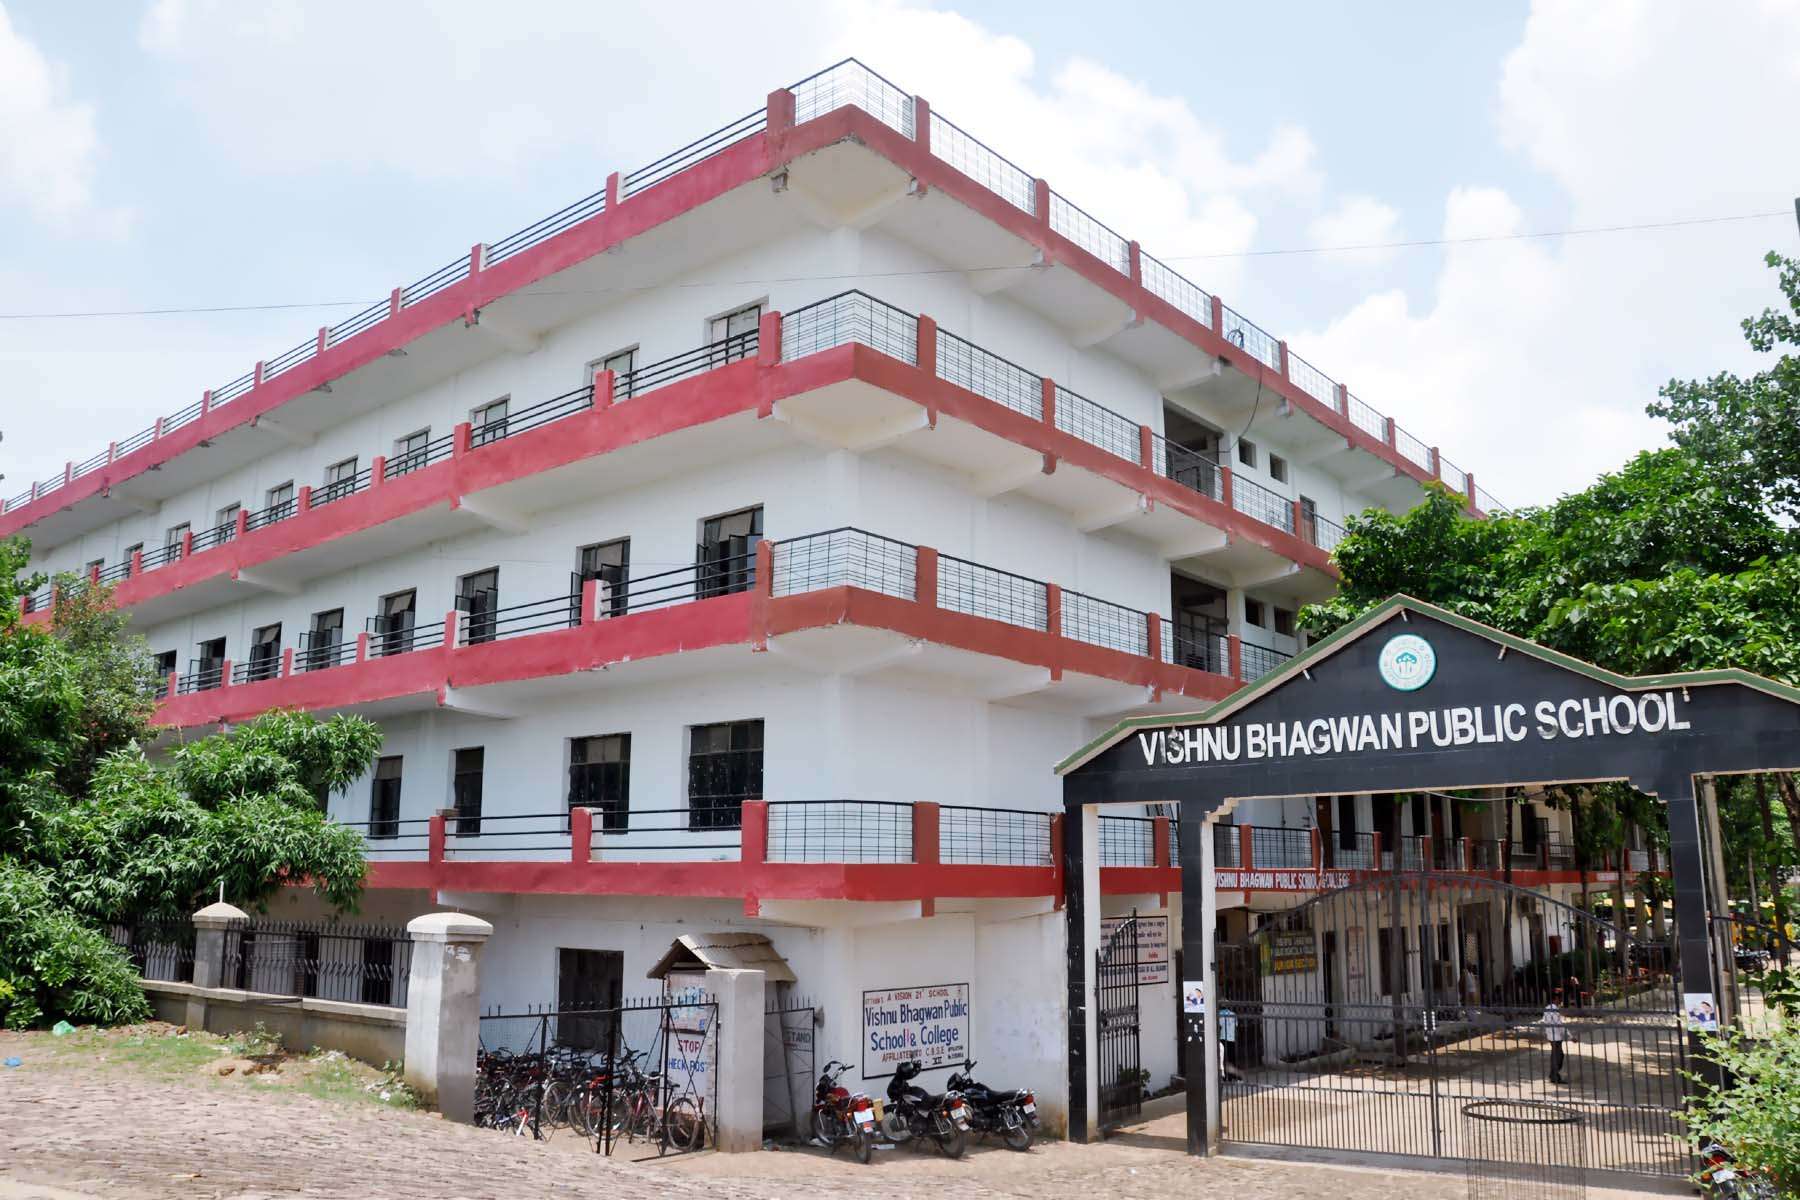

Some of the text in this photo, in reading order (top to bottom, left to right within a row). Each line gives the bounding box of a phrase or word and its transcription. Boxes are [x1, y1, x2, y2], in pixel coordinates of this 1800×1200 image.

[1139, 691, 1691, 766] VISHNU BHAGWAN PUBLIC SCHOOL
[1215, 872, 1238, 888] VISHNU
[1240, 872, 1274, 889] BHAGWAN
[1276, 872, 1297, 889] PUBLIC
[1299, 872, 1319, 889] SCHOOL
[887, 991, 892, 1001] A
[895, 991, 912, 1001] VISION
[928, 988, 949, 998] SCHOOL
[865, 999, 967, 1026] Vishnu Bhagwan Public
[678, 1039, 700, 1052] STOP
[871, 1025, 959, 1051] School & College
[668, 1057, 706, 1072] HECK POS
